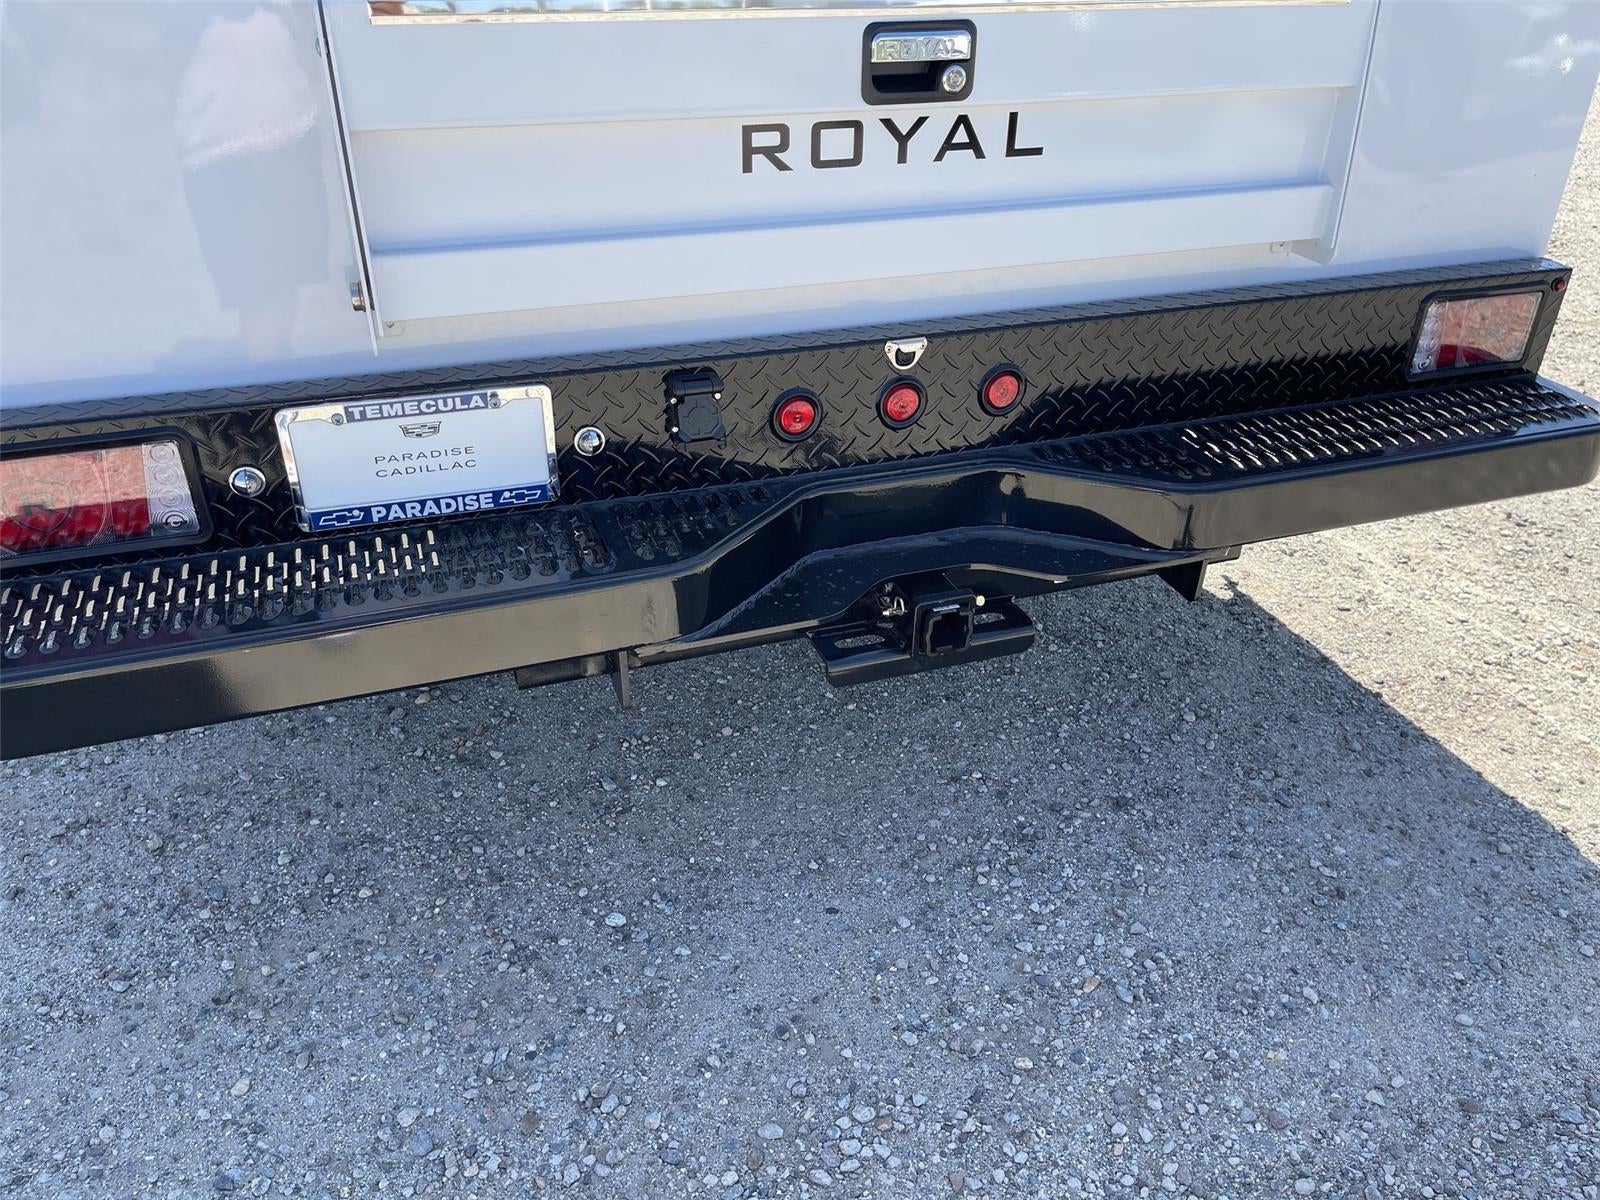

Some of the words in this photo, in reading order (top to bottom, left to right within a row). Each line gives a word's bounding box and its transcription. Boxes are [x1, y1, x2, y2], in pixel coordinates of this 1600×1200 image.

[882, 37, 966, 59] ROYAL
[742, 111, 1044, 173] ROYAL
[349, 394, 486, 421] TEMECULA
[374, 446, 475, 464] PARADISE
[375, 459, 477, 478] CADILLAC
[371, 492, 494, 522] PARADISE
